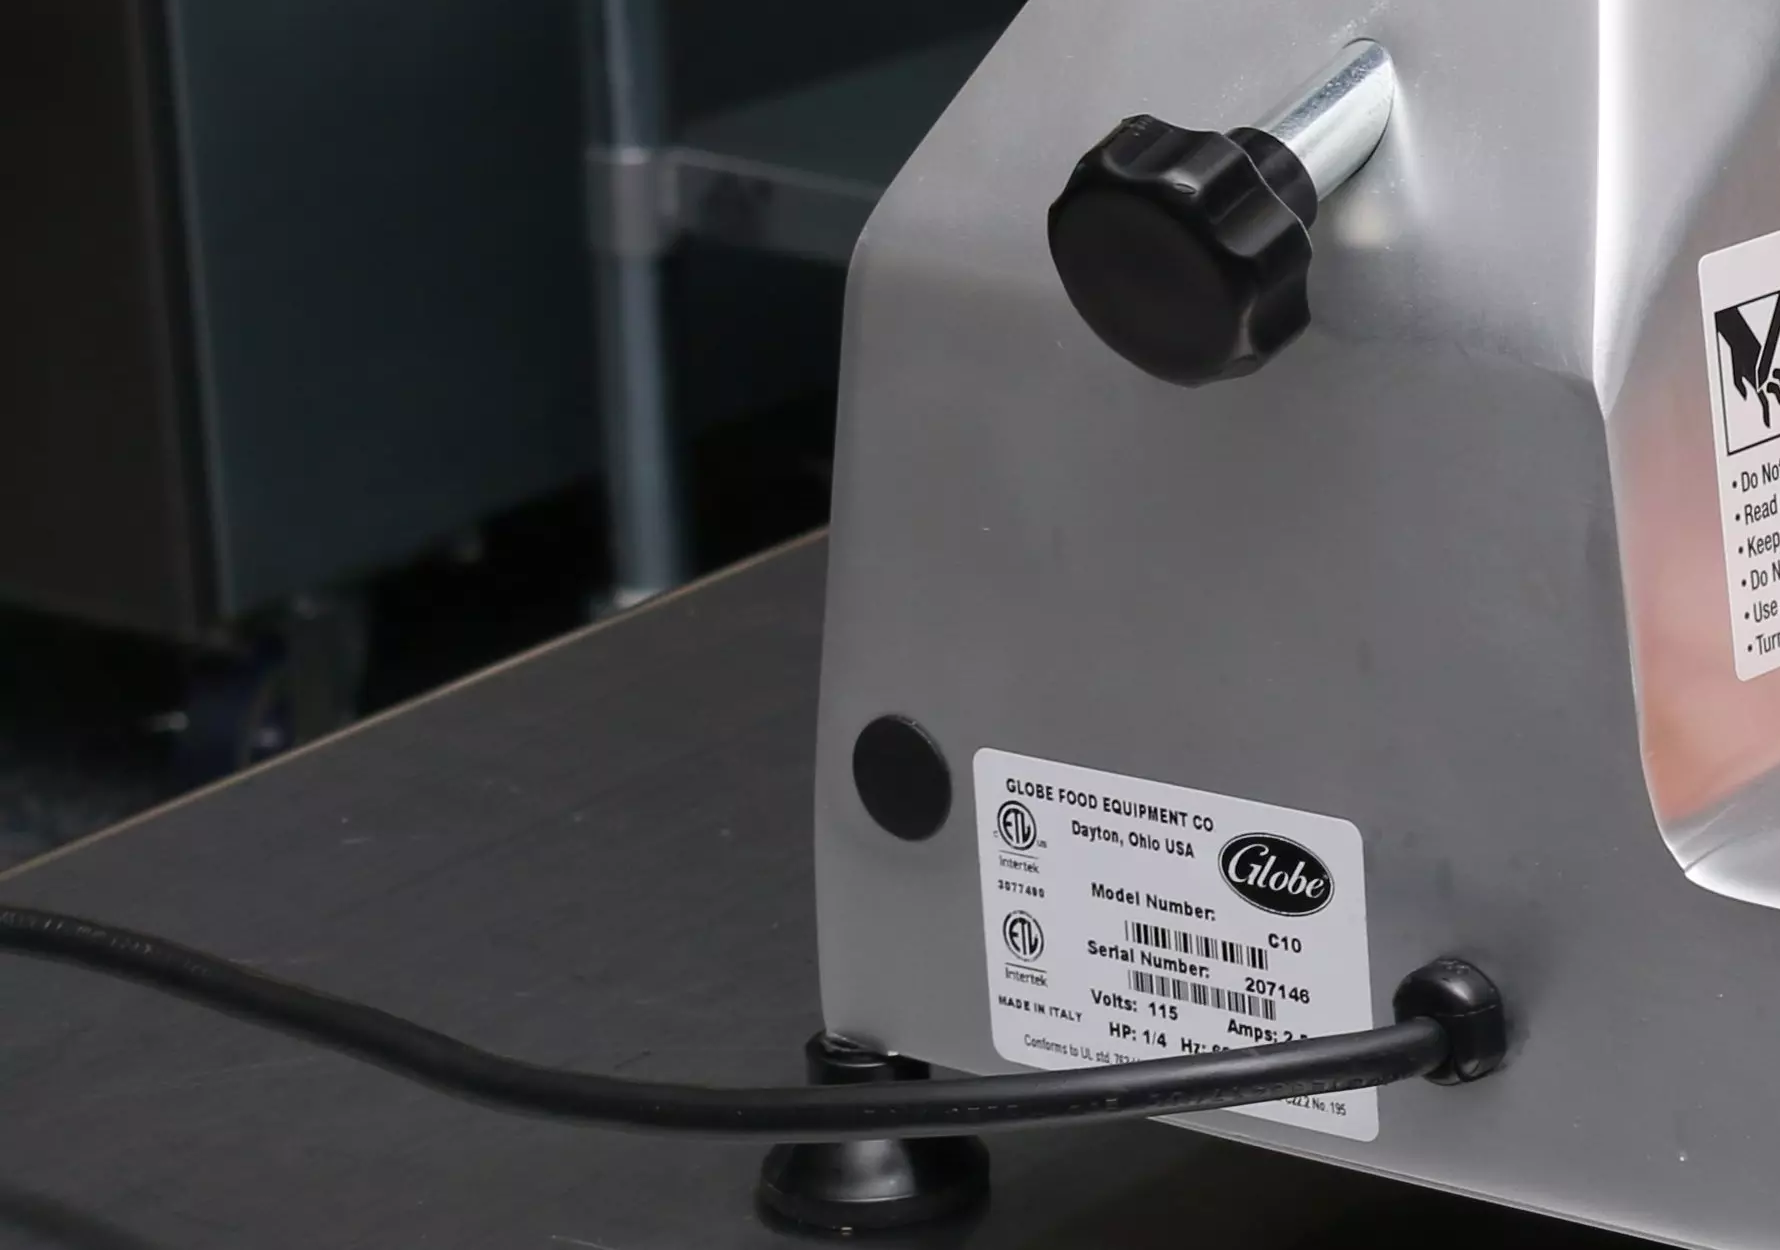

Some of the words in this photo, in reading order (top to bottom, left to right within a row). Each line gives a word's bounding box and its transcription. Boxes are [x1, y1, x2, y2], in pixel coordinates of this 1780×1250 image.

[1741, 471, 1758, 493] Do
[1744, 494, 1778, 526] Read
[1747, 531, 1780, 558] Keep
[1750, 569, 1768, 591] Do
[1753, 599, 1778, 624] Use
[1006, 778, 1054, 801] GLOBE
[1058, 788, 1098, 809] FOOD
[1103, 797, 1189, 828] EQUIPMENT
[1192, 814, 1215, 832] CO
[1071, 819, 1124, 847] Dayton,
[1128, 832, 1160, 851] Ohio
[1165, 838, 1195, 859] USA
[999, 855, 1039, 874] Intertek
[1228, 843, 1325, 899] Globe
[1091, 881, 1140, 906] Model
[1146, 893, 1216, 921] Number:
[1268, 933, 1302, 953] C10
[1088, 939, 1134, 963] Serial
[1140, 950, 1210, 979] Number:
[1005, 967, 1048, 988] Intertek
[1245, 977, 1311, 1004] 207146
[998, 994, 1030, 1011] MADE
[1034, 1002, 1046, 1015] IN
[1049, 1006, 1083, 1023] ITALY
[1090, 988, 1138, 1012] Volts:
[1148, 1001, 1179, 1021] 115
[1109, 1022, 1137, 1042] HP:
[1143, 1029, 1167, 1049] 1/4
[1227, 1018, 1278, 1043] Amps:
[1023, 1033, 1068, 1055] Conforms
[1069, 1044, 1079, 1057] to
[1080, 1046, 1094, 1061] UL
[1330, 1101, 1347, 1116] 195
